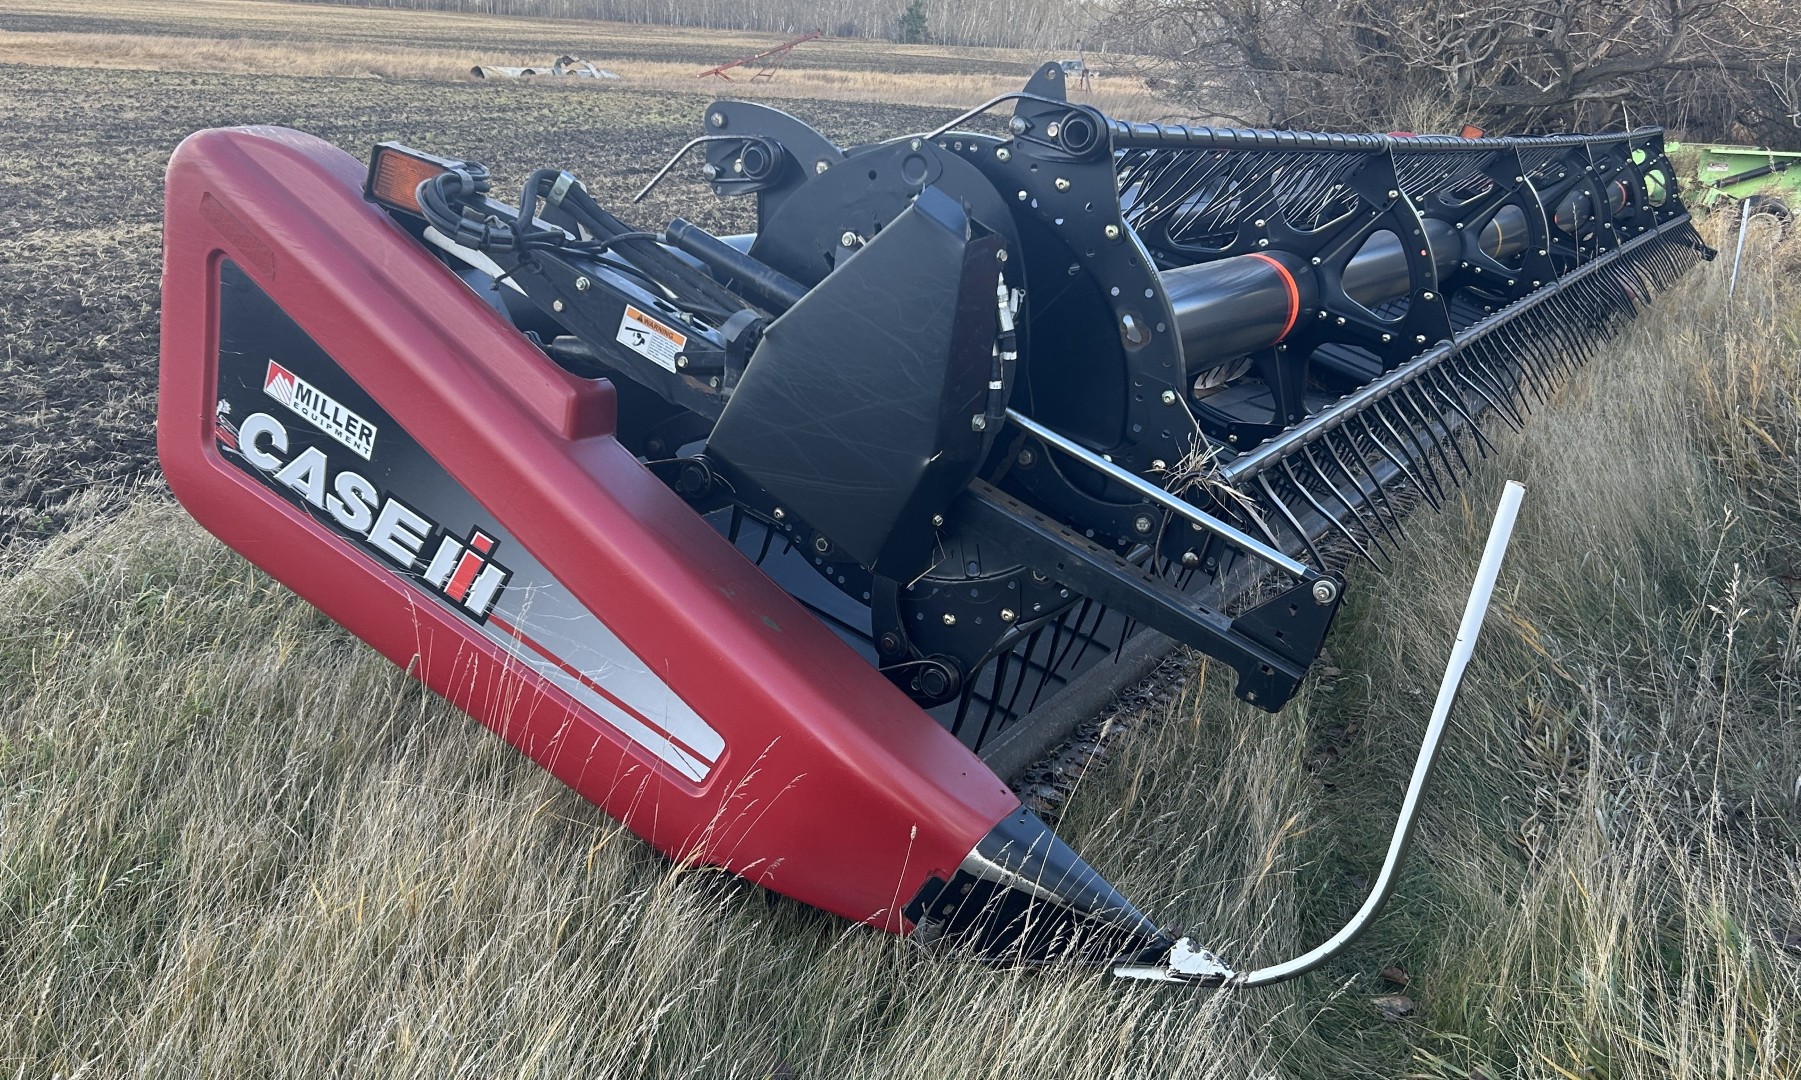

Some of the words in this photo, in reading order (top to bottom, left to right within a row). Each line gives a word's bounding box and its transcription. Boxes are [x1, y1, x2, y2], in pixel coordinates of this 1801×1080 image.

[641, 315, 674, 340] WARNING
[293, 402, 371, 455] EQUIPMENT
[295, 382, 373, 447] MILLER
